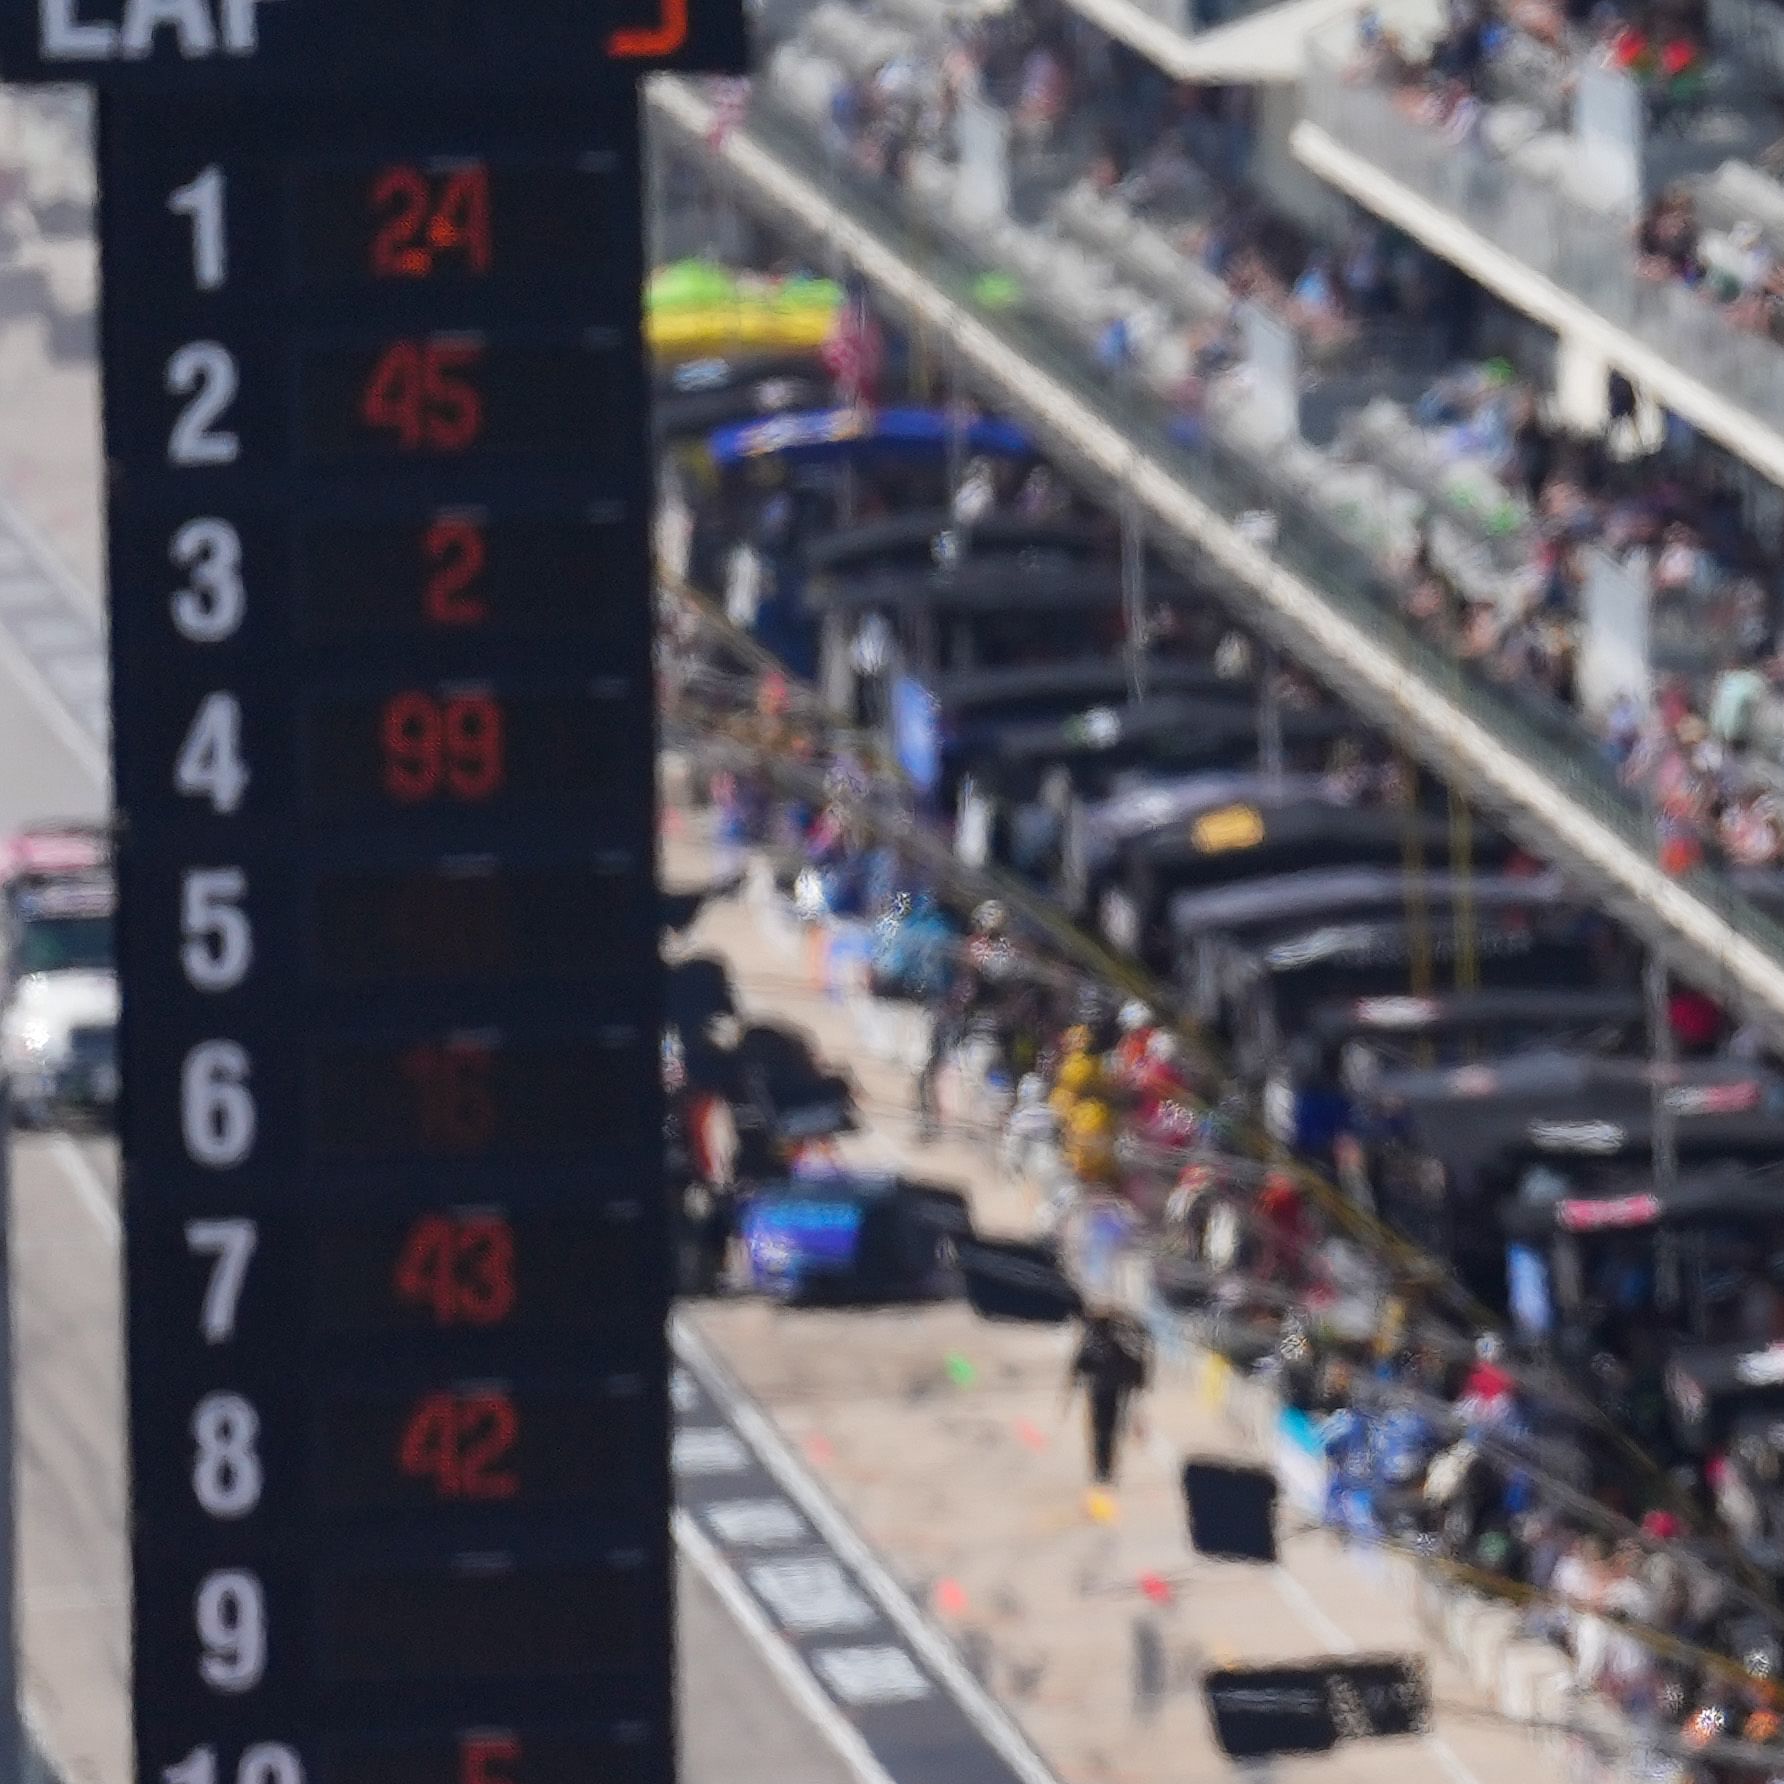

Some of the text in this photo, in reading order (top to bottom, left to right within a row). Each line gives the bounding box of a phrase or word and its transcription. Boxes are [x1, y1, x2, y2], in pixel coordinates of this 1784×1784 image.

[167, 164, 491, 290] 1 24
[163, 341, 484, 467] 2 45
[170, 516, 487, 644] 3 2
[173, 690, 506, 814] 4 99
[179, 866, 253, 993] 5
[181, 1040, 257, 1168] 6
[184, 1213, 518, 1346] 7 43
[191, 1390, 521, 1520] 8 42
[195, 1568, 269, 1693] 9
